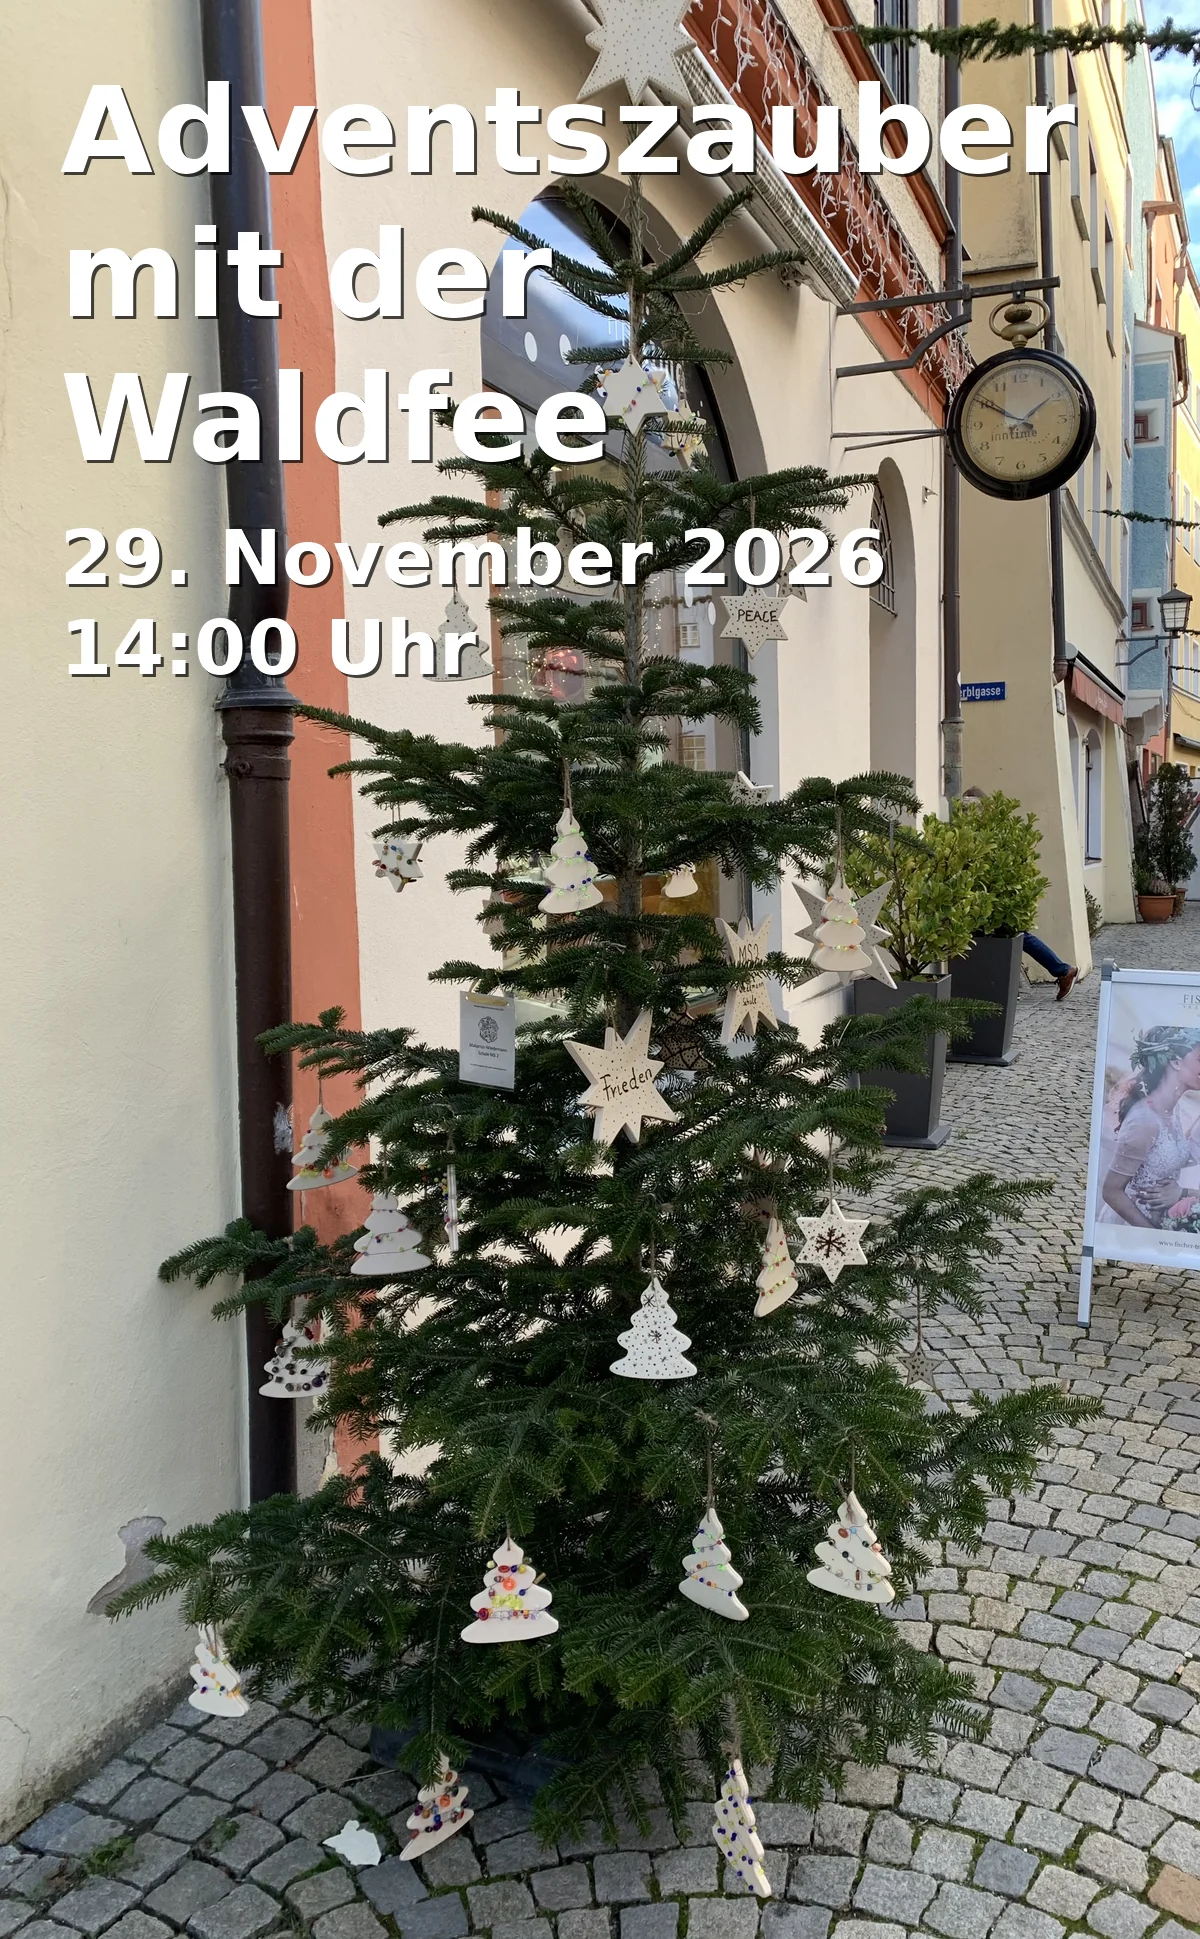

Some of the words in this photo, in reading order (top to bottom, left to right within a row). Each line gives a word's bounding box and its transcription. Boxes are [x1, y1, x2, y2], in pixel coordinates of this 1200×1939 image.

[1012, 374, 1028, 383] 12
[995, 382, 1006, 392] 11
[1057, 414, 1068, 424] 3
[973, 421, 983, 430] 9
[991, 427, 1037, 441] inntime
[1051, 435, 1060, 445] 4
[980, 441, 990, 450] 8
[994, 456, 1005, 466] 7
[1036, 453, 1047, 463] 5
[1016, 461, 1025, 470] 6
[737, 608, 778, 622] PEACE
[600, 1066, 653, 1101] Frieden
